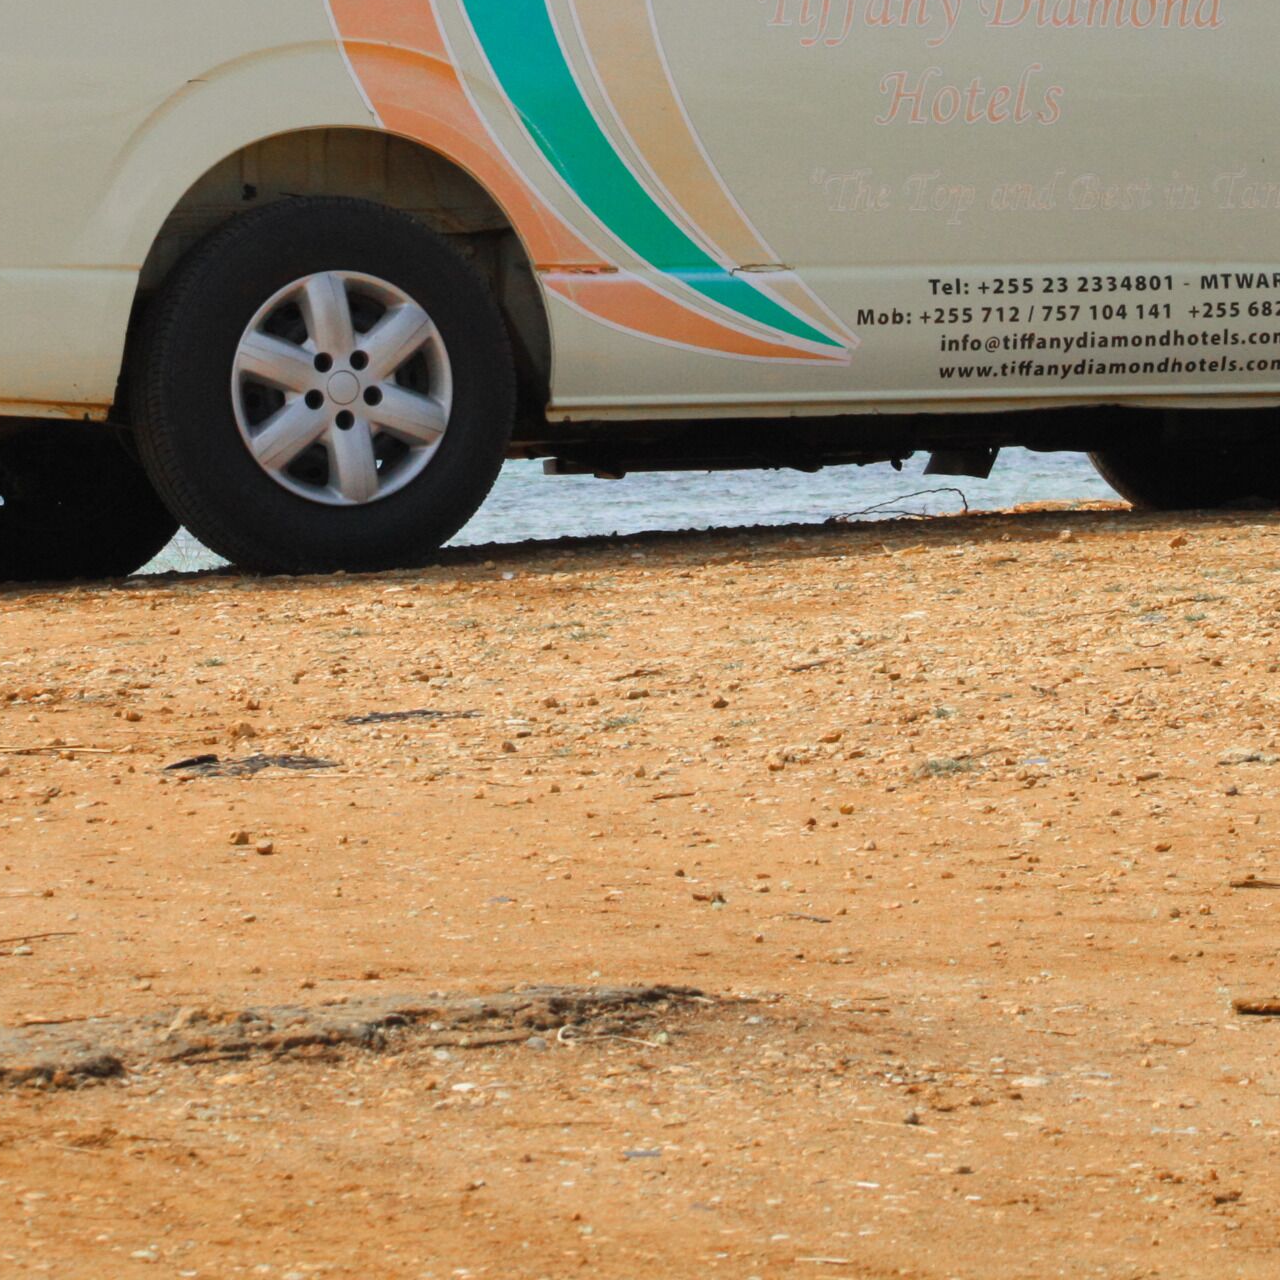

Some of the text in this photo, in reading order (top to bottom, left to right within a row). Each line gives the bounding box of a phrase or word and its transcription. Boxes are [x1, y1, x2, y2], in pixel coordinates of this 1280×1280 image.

[874, 62, 1064, 125] Hotels
[902, 169, 976, 225] Top
[988, 167, 1066, 211] and
[1070, 172, 1152, 211] Best
[1165, 169, 1201, 211] in
[928, 278, 970, 295] Tel:
[977, 277, 1034, 295] +255
[1042, 277, 1069, 293] 23
[1077, 275, 1173, 293] 2334801
[857, 307, 912, 326] Mob:
[920, 307, 973, 324] +255
[981, 306, 1020, 322] 712
[1028, 305, 1035, 323] /
[1042, 305, 1081, 321] 757
[1089, 304, 1128, 320] 104
[1136, 303, 1172, 320] 141
[1188, 301, 1241, 319] +255
